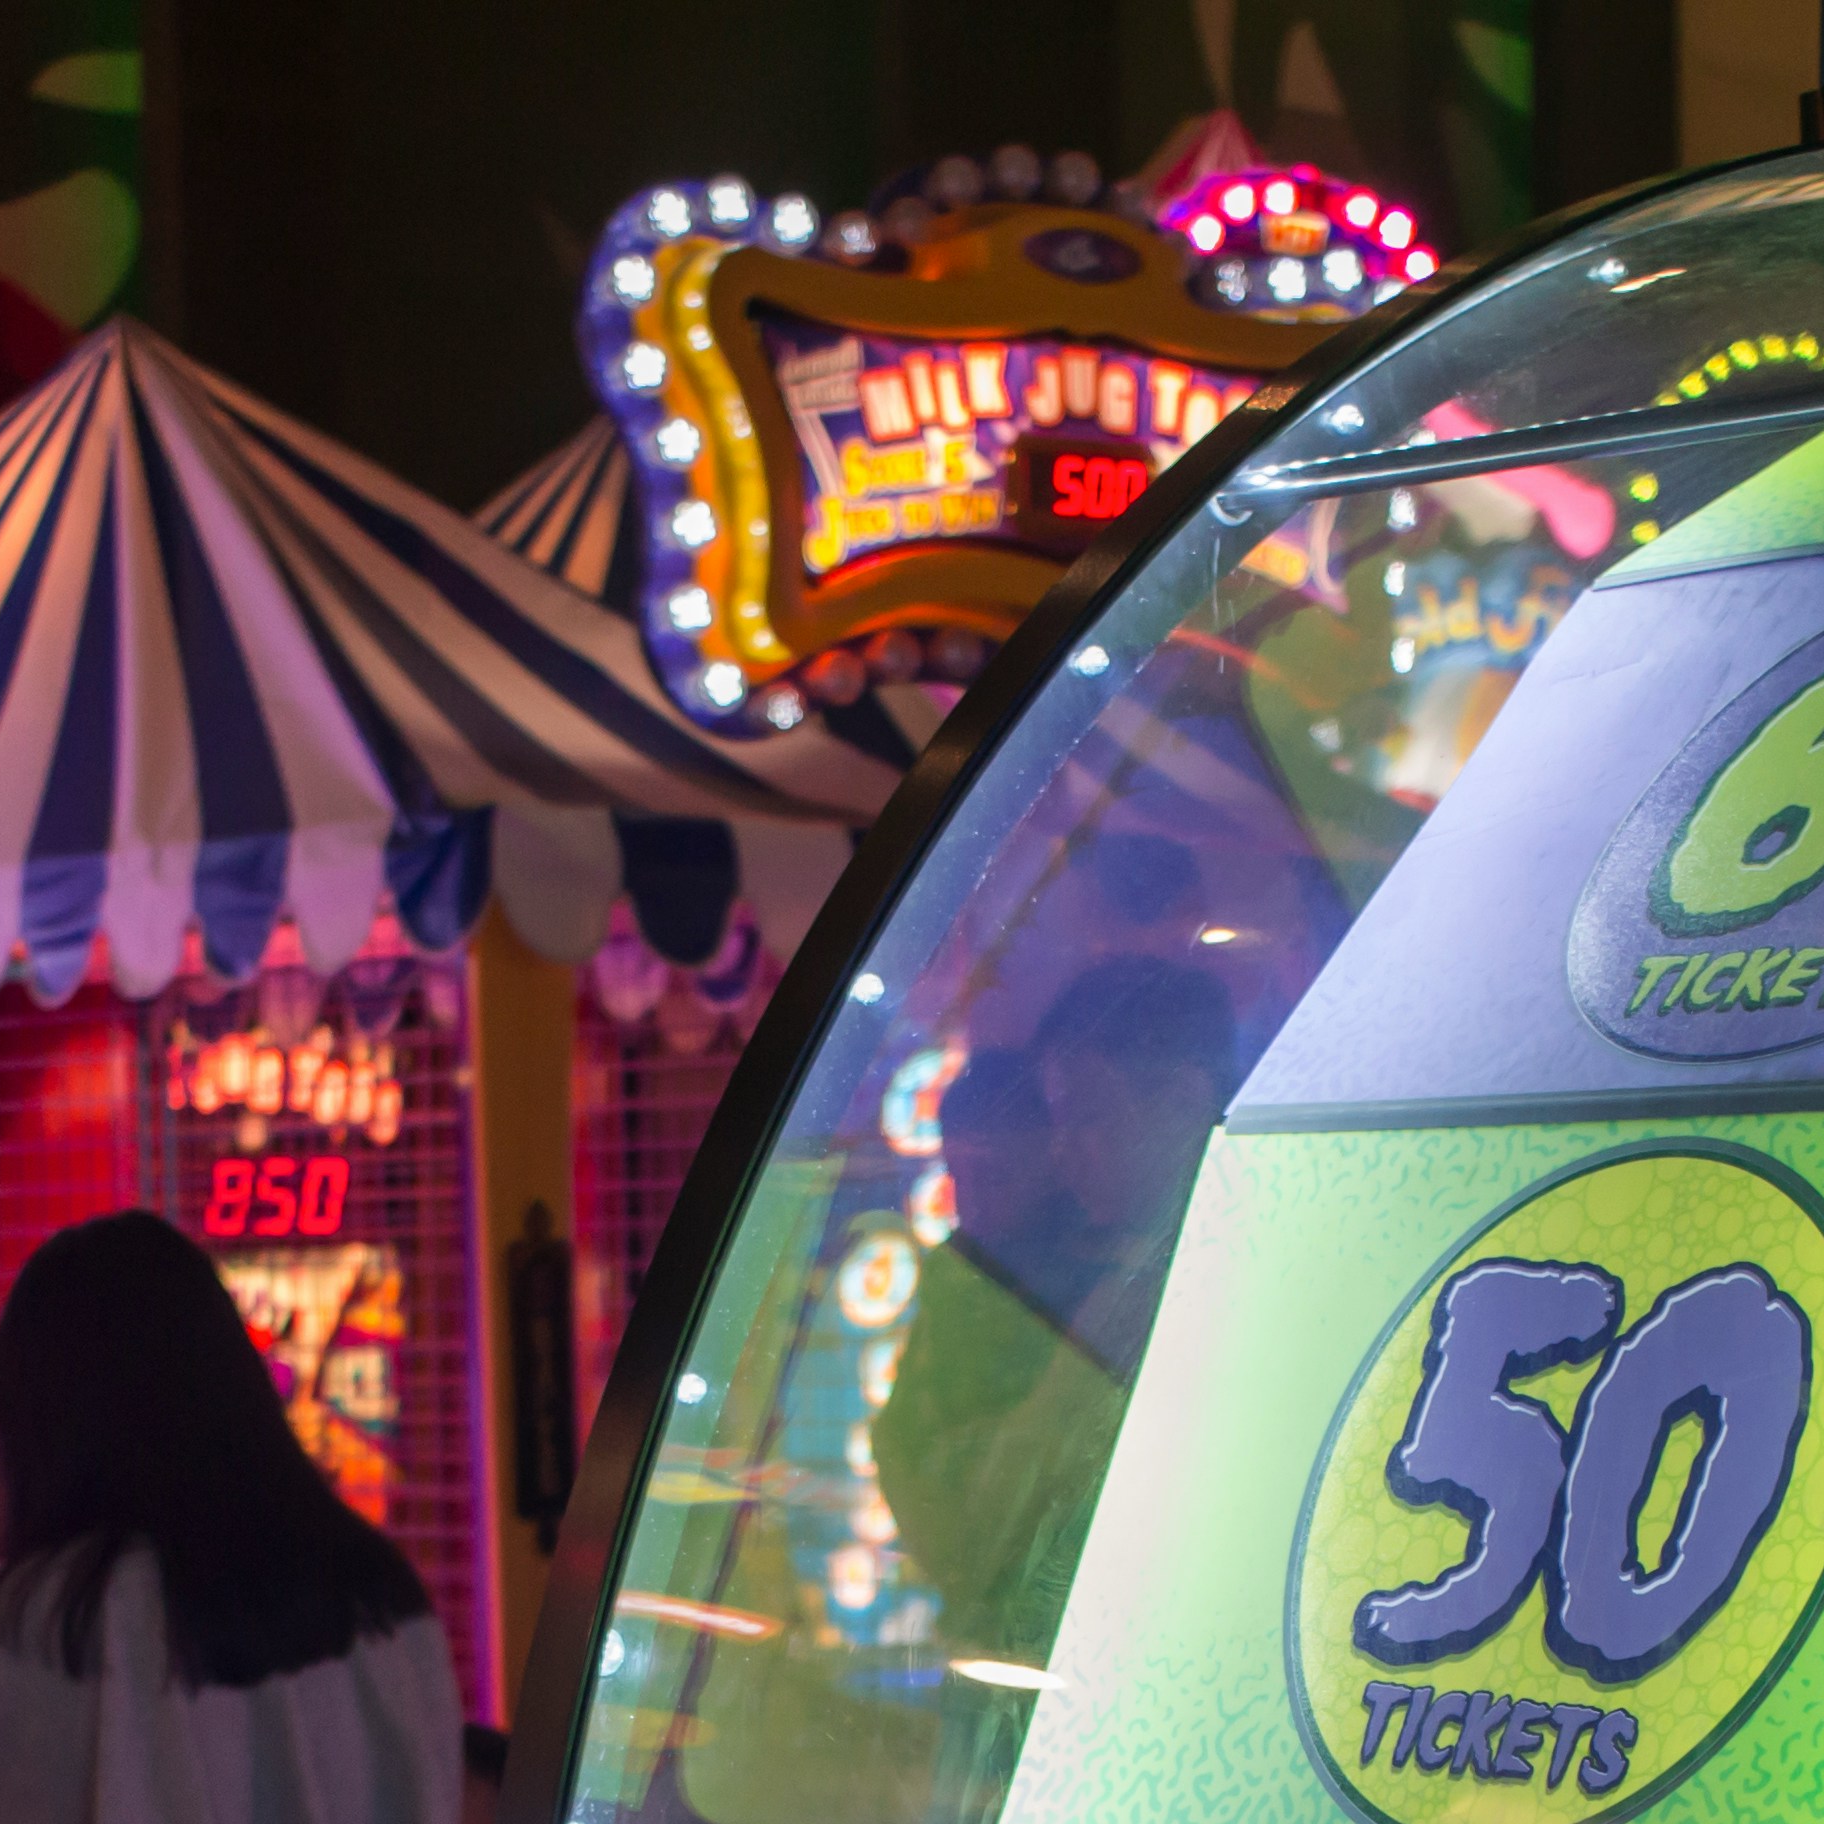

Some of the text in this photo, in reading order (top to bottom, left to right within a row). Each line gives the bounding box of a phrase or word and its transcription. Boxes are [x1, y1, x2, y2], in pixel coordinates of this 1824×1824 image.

[859, 343, 1012, 441] MILK
[1026, 345, 1138, 435] JUG
[945, 440, 969, 484] 5
[202, 1156, 350, 1237] 850
[1353, 1256, 1813, 1687] 50
[1360, 1680, 1640, 1794] TICKETS
